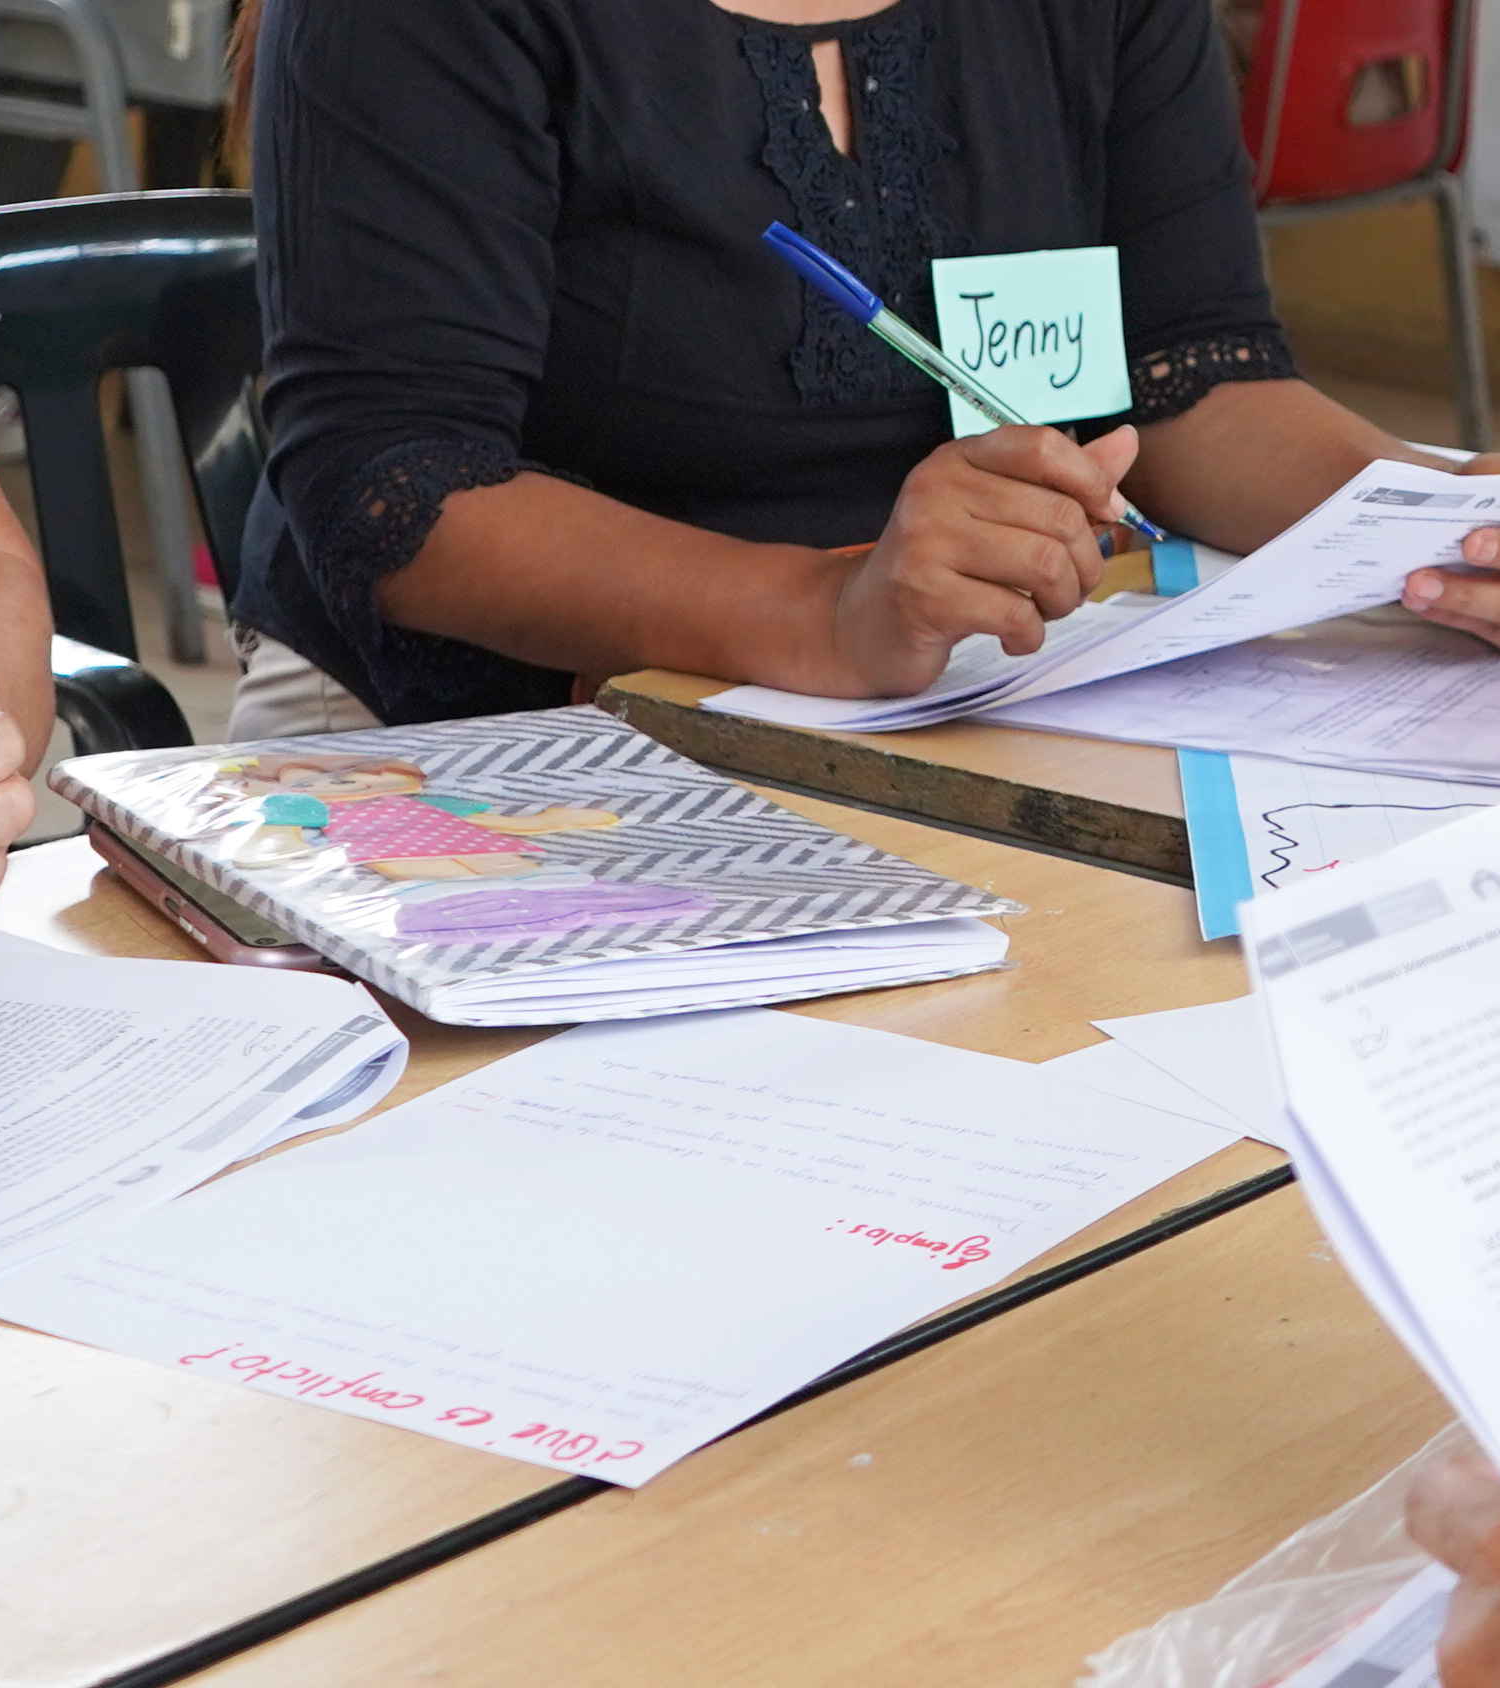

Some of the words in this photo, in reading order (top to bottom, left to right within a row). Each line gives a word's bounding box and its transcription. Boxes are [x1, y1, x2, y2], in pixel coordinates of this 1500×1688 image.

[959, 292, 1083, 388] Jenny
[178, 1341, 427, 1410] conflicto?
[435, 1406, 495, 1427] es
